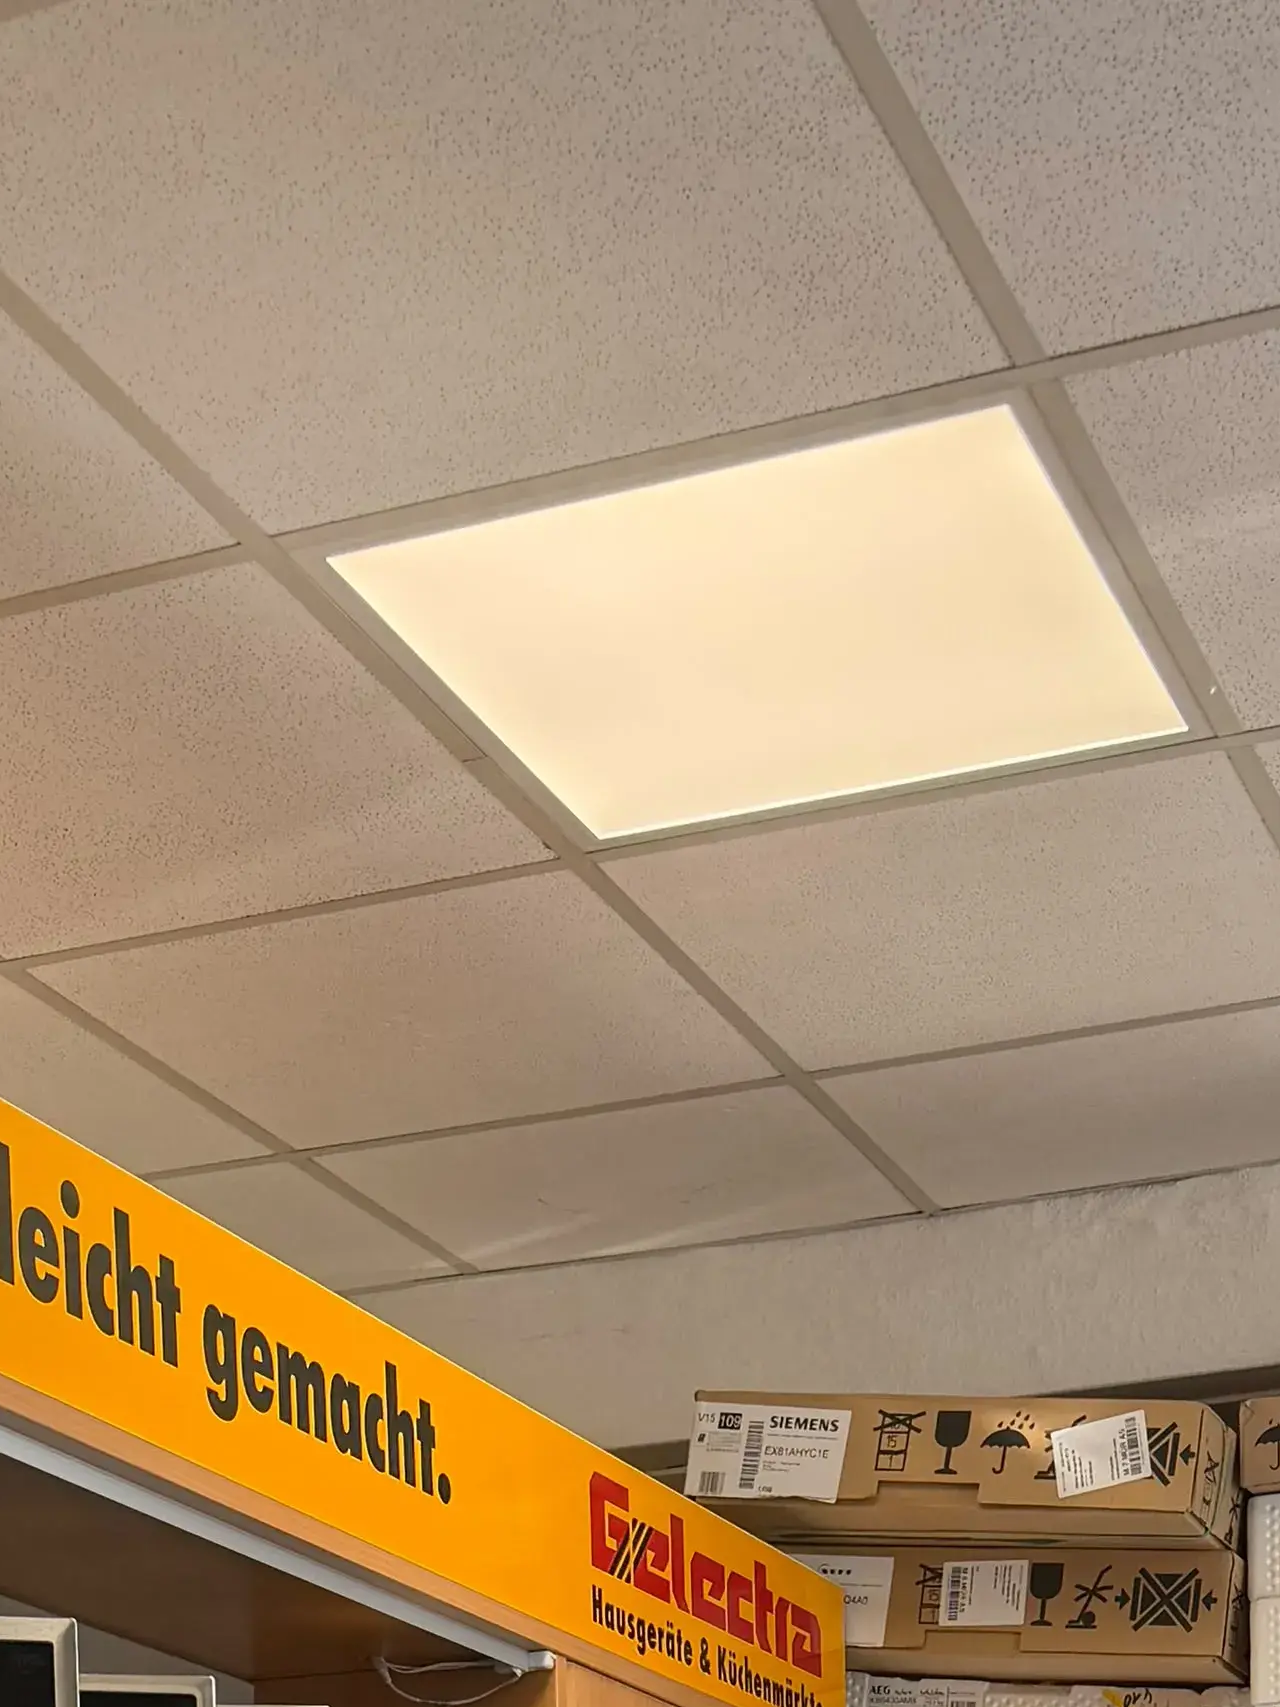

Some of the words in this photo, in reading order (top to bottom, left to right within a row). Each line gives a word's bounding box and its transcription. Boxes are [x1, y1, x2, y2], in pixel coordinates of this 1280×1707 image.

[203, 1303, 451, 1504] gemacht.
[720, 1414, 742, 1429] 109
[770, 1415, 839, 1432] SIEMENS
[887, 1435, 897, 1448] 15
[591, 1584, 692, 1666] Hausgeräte
[699, 1637, 711, 1676] &
[871, 1685, 891, 1695] AEG
